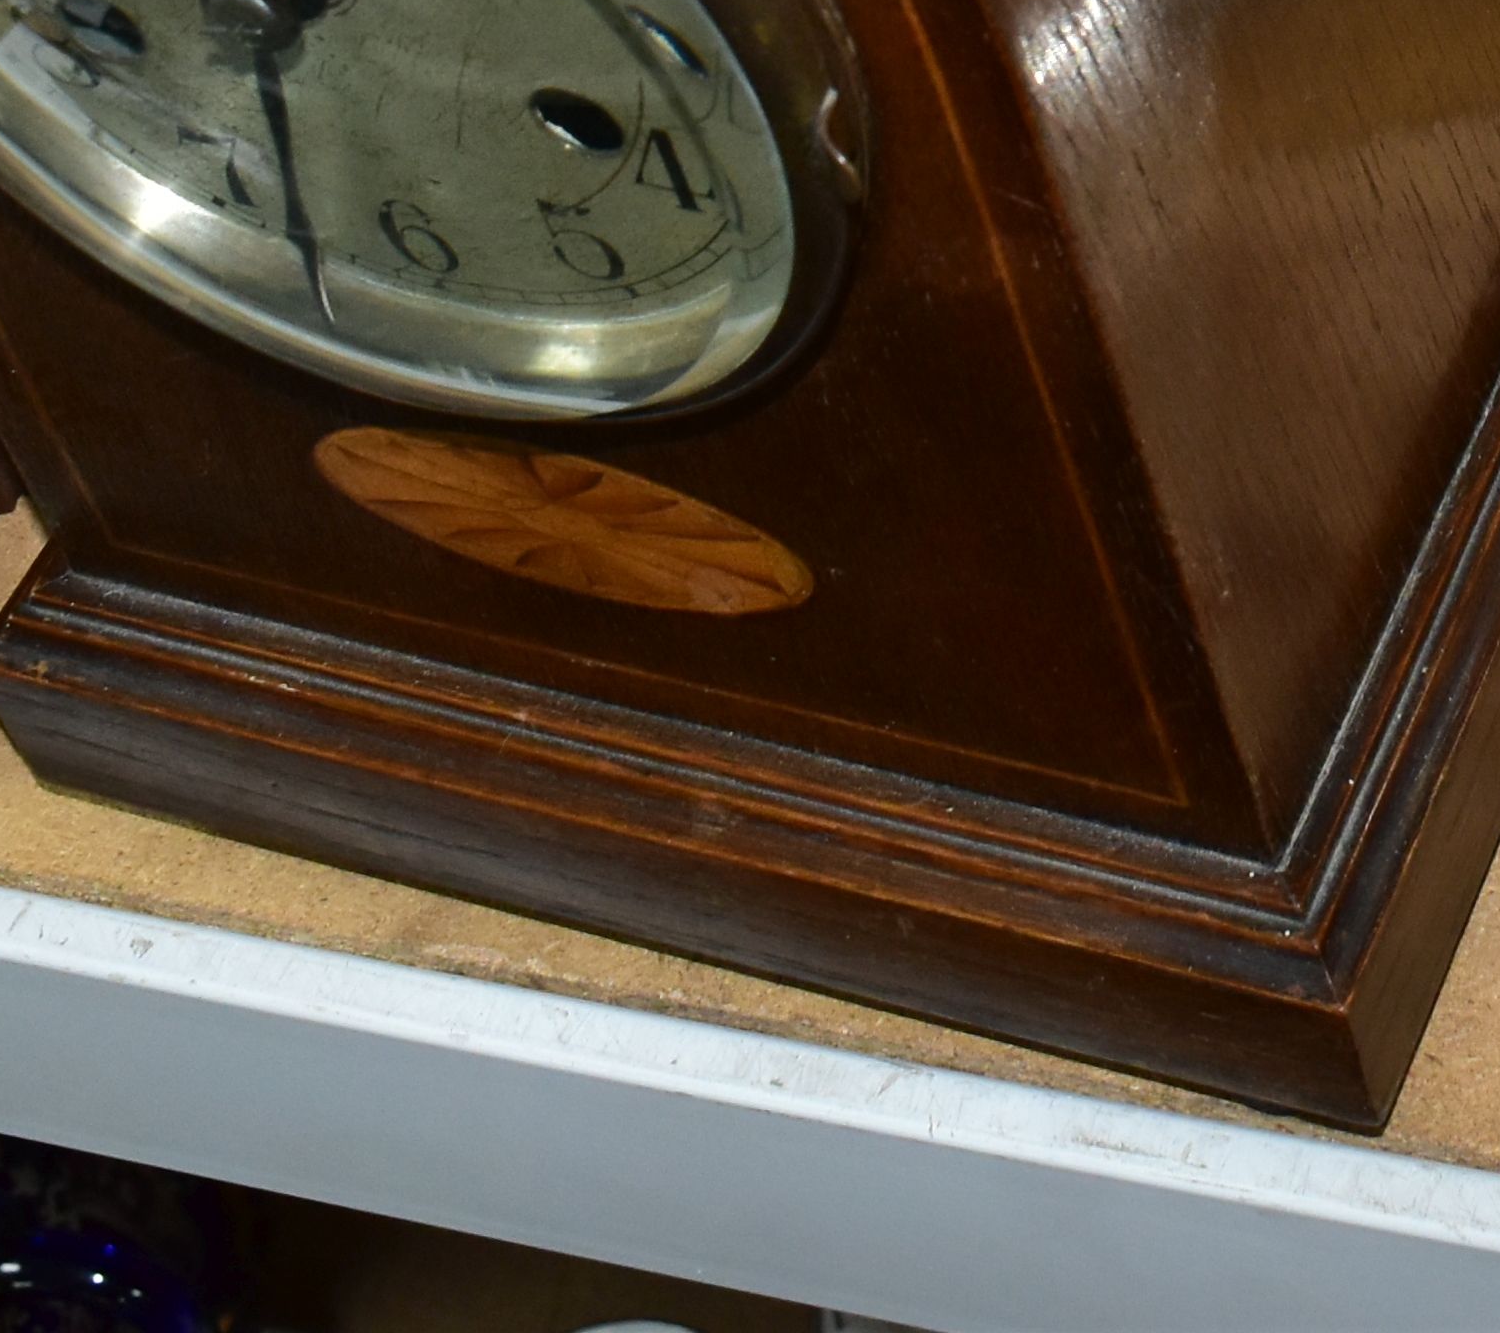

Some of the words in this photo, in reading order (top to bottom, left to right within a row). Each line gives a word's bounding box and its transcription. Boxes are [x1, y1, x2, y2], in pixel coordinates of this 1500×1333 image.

[634, 128, 715, 213] 4
[378, 198, 459, 272] 6
[535, 197, 625, 280] 5
